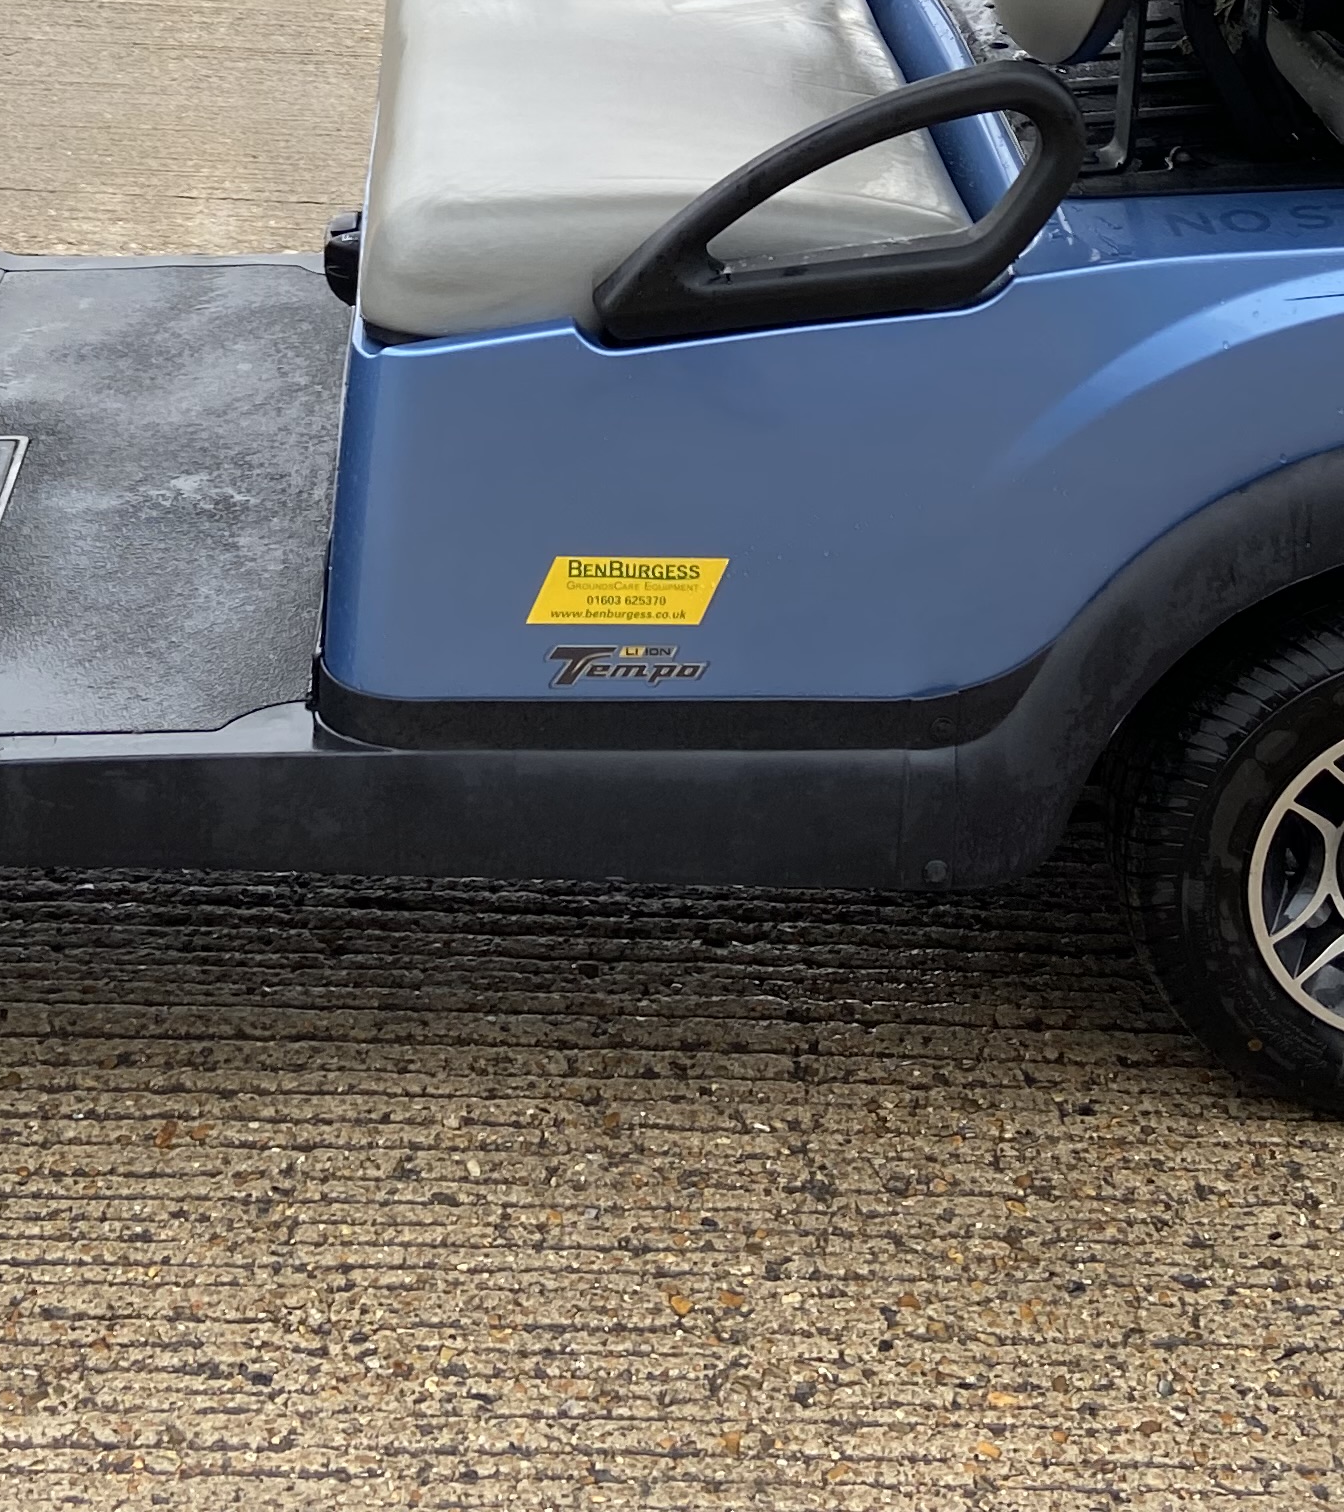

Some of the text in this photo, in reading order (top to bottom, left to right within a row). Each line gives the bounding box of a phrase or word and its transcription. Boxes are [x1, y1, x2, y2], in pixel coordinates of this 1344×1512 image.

[1165, 208, 1271, 237] NO
[586, 595, 622, 606] 01603
[550, 609, 687, 621] www.benburgess.co.uk
[549, 645, 707, 686] Tempo
